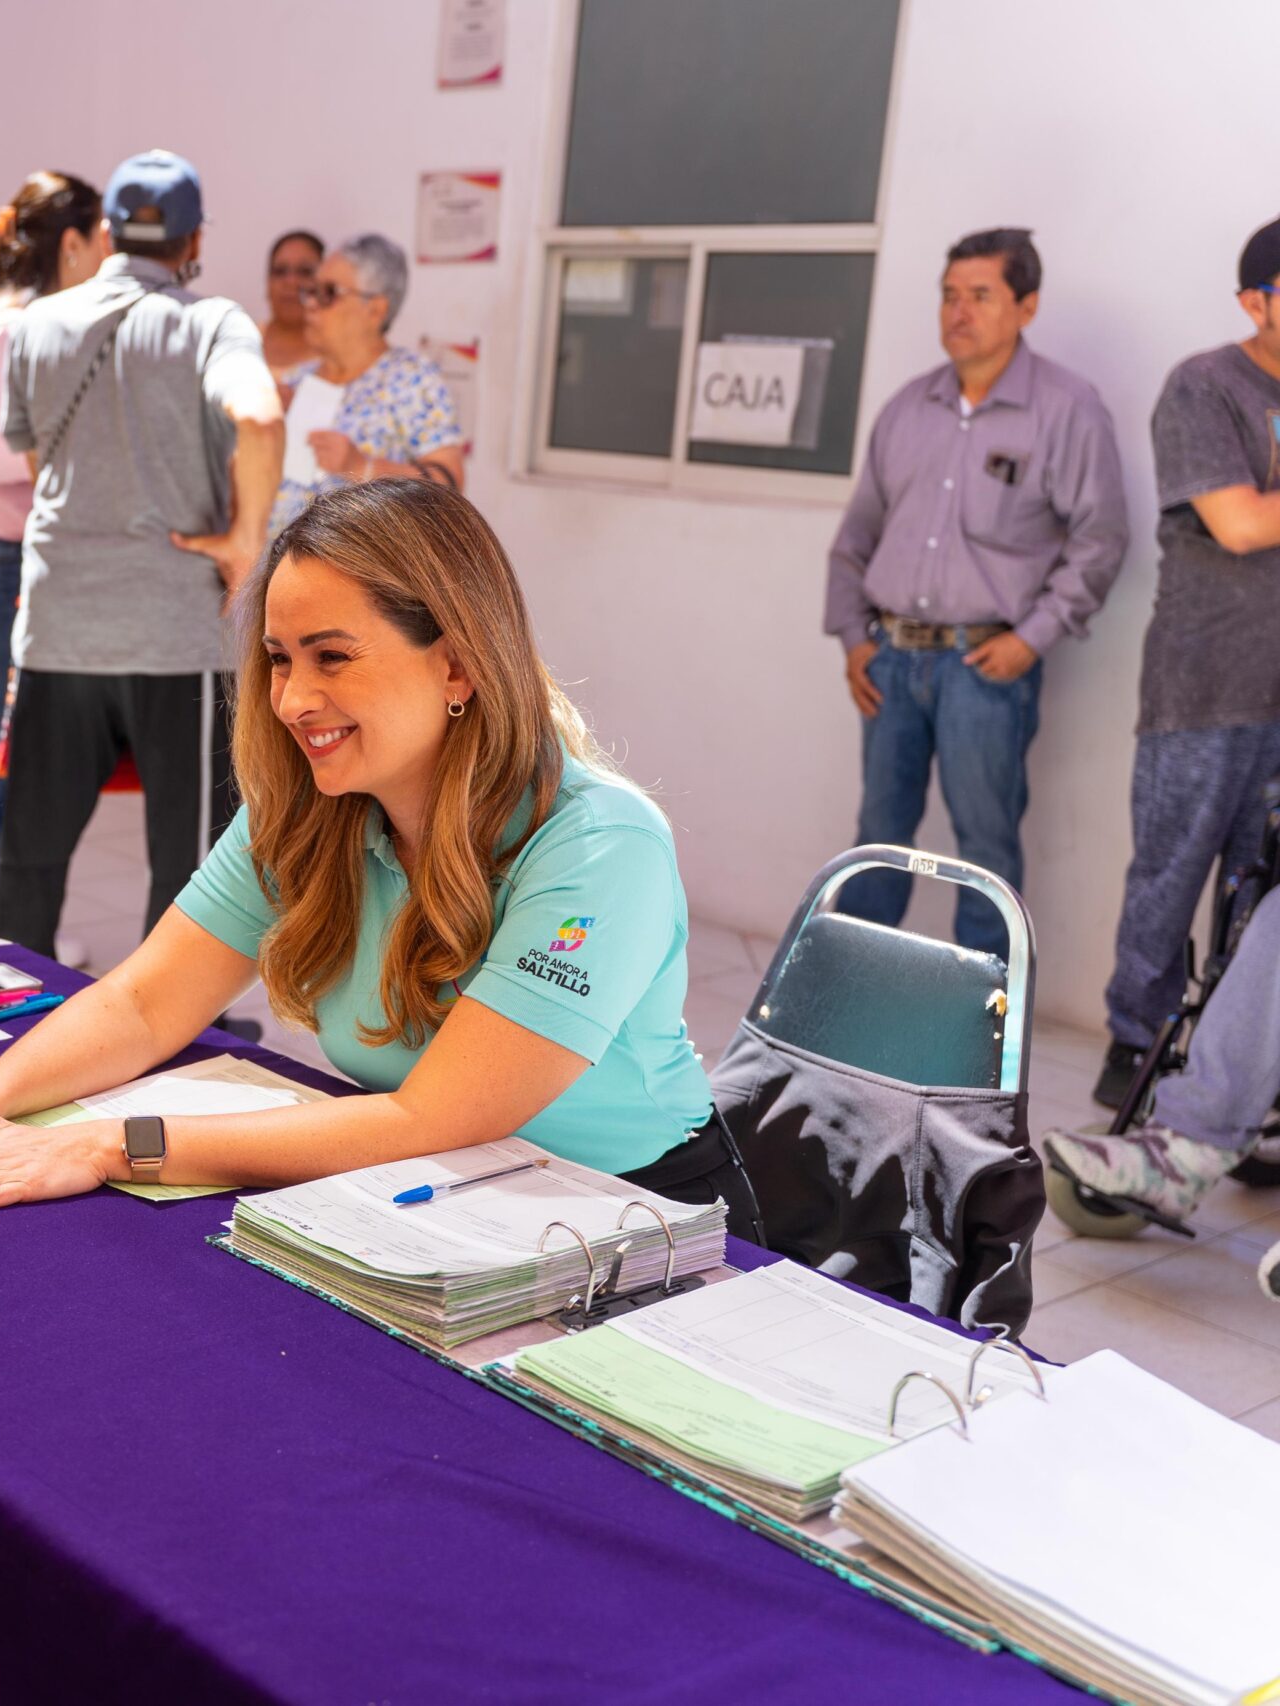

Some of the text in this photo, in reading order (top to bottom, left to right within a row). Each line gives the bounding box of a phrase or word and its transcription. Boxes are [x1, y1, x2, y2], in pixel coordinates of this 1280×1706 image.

[703, 371, 785, 412] CAJA
[516, 957, 591, 997] SALTILLO
[528, 948, 589, 981] POR AMOR A
